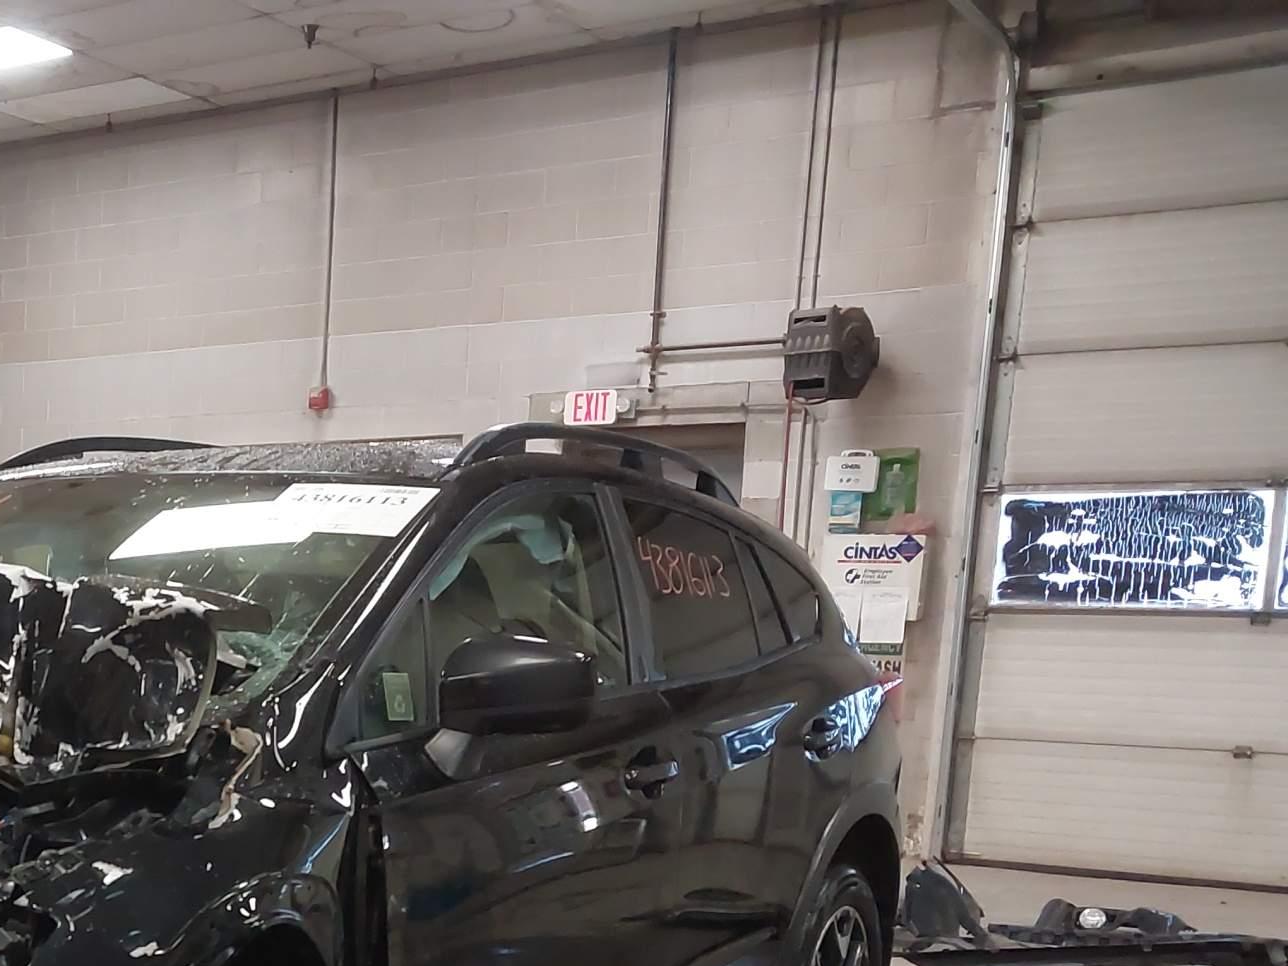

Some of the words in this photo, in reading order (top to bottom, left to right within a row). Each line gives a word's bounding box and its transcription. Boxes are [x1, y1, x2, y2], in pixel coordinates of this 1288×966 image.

[573, 392, 610, 422] EXIT
[637, 536, 730, 599] 43816113
[873, 660, 901, 674] ASH
